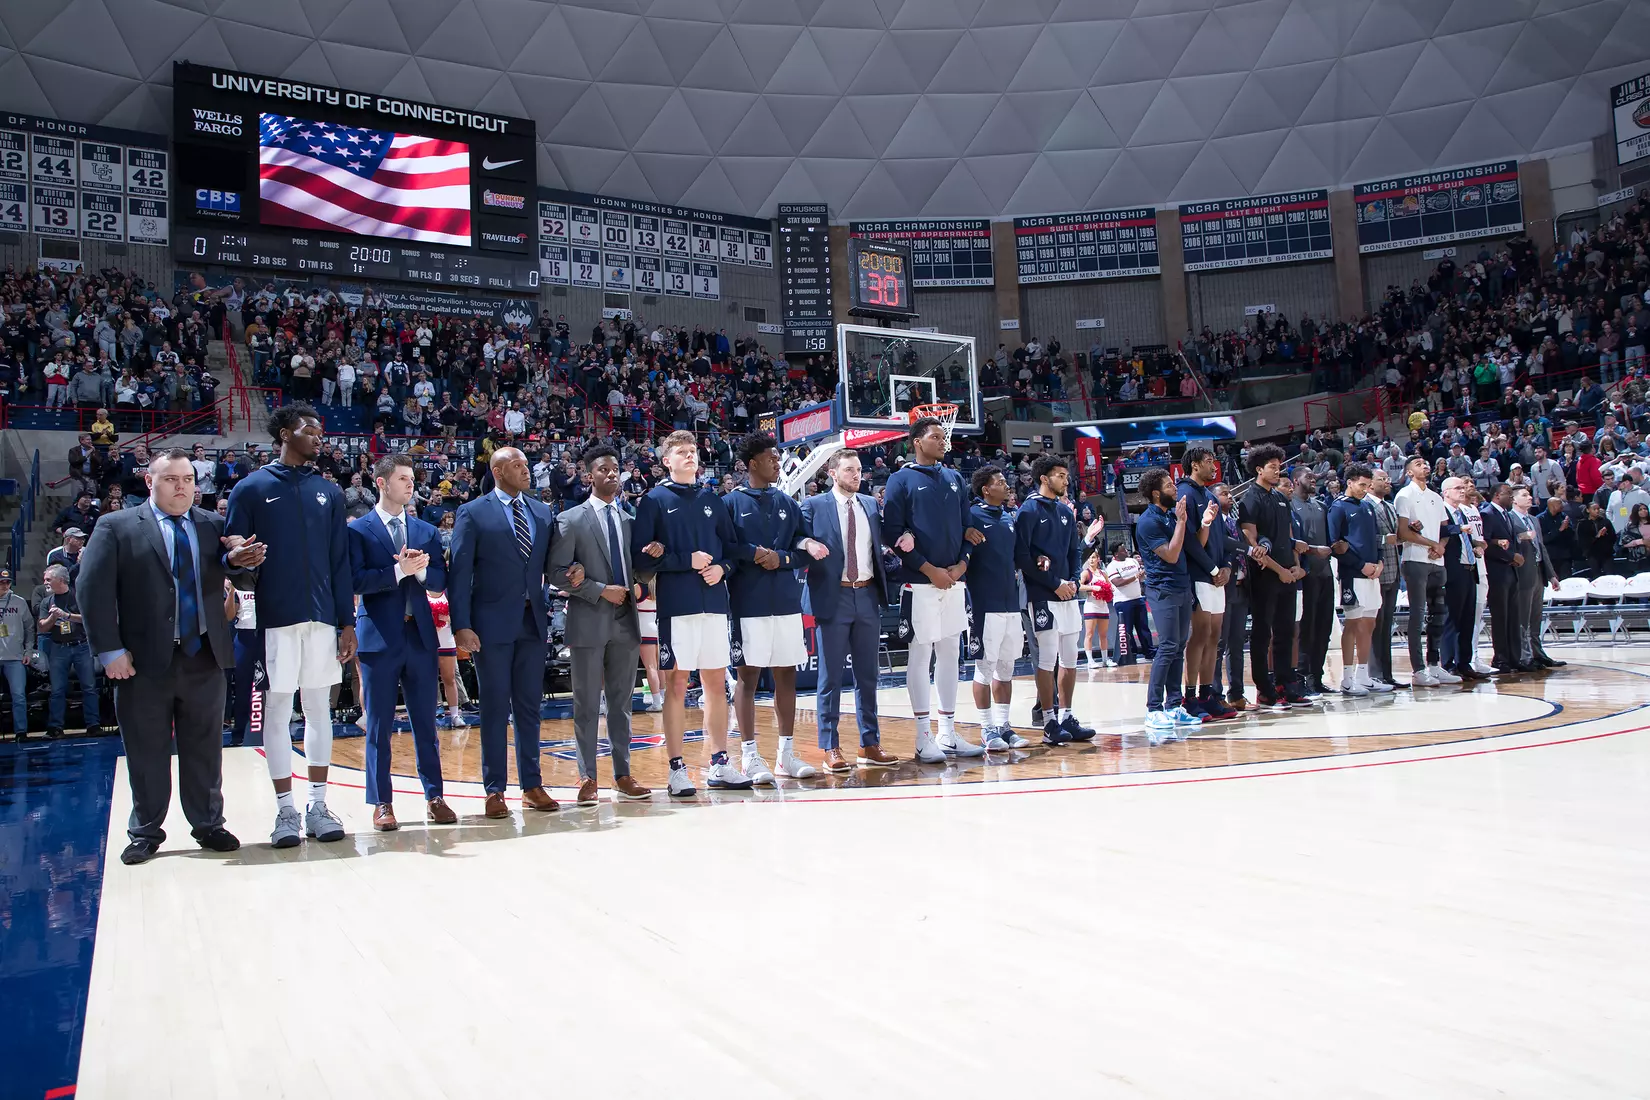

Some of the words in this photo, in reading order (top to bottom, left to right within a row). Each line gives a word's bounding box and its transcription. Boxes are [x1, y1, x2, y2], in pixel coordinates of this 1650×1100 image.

[212, 72, 340, 105] UNIVERSITY
[346, 94, 371, 110] OF
[377, 98, 508, 134] CONNECTICUT
[192, 108, 243, 125] WELLS
[8, 116, 26, 125] OF
[36, 120, 87, 134] HONOR
[194, 120, 242, 137] FARGO
[38, 156, 72, 177] 44
[132, 169, 164, 188] 42
[1364, 181, 1398, 193] NCAA
[1405, 164, 1507, 187] CHAMPIONSHIP
[1405, 186, 1433, 195] FINAL
[1438, 180, 1465, 189] FOUR
[1615, 188, 1634, 200] 218
[196, 189, 236, 204] CBS
[1188, 203, 1220, 213] NCAA
[1226, 192, 1319, 209] CHAMPIONSHIP
[42, 206, 68, 227] 13
[594, 198, 626, 208] UCONN
[632, 203, 672, 214] HUSKIES
[694, 212, 724, 222] HONOR
[1255, 206, 1282, 214] EIGHT
[88, 212, 117, 232] 22
[895, 222, 982, 230] CHAMPIONSHIP
[1022, 218, 1053, 226] NCAA
[1059, 211, 1147, 224] CHAMPIONSHIP
[542, 220, 564, 236] 52
[606, 227, 626, 243] 00
[1248, 230, 1264, 240] 2014
[320, 241, 340, 249] BONUS
[482, 232, 520, 243] TRAVELERS
[638, 232, 656, 246] 13
[666, 236, 686, 250] 42
[1364, 238, 1424, 252] CONNECTICUT
[1428, 234, 1455, 242] MEN'S
[1458, 226, 1518, 238] BASKETBALL
[194, 237, 206, 256] 0
[350, 246, 390, 263] 20:00
[699, 239, 710, 254] 34
[728, 242, 738, 258] 32
[754, 246, 766, 260] 50
[222, 252, 241, 262] FULL
[260, 256, 270, 264] 30
[272, 257, 287, 266] SEC
[306, 260, 318, 268] TM
[861, 252, 901, 274] 20:00
[914, 254, 930, 263] 2014
[1188, 260, 1243, 270] CONNECTICUT
[1276, 252, 1328, 261] BASKETBALL
[408, 270, 418, 278] TM
[420, 272, 432, 280] FLS
[549, 261, 560, 276] 15
[580, 264, 592, 280] 22
[1022, 274, 1076, 282] CONNECTICUT
[1106, 268, 1156, 277] BASKETBALL
[460, 275, 472, 283] SEC
[489, 278, 504, 286] FULL
[529, 270, 538, 286] 0
[642, 271, 654, 287] 42
[671, 274, 684, 290] 13
[704, 278, 709, 292] 3
[868, 273, 899, 307] 30
[379, 292, 399, 300] Harry
[410, 294, 436, 303] Gampel
[438, 296, 464, 306] Pavilion
[470, 300, 492, 308] Storrs,
[390, 302, 425, 311] Basketbll
[426, 305, 450, 313] Capital
[806, 338, 826, 350] 1:58
[1118, 623, 1128, 656] UCONN
